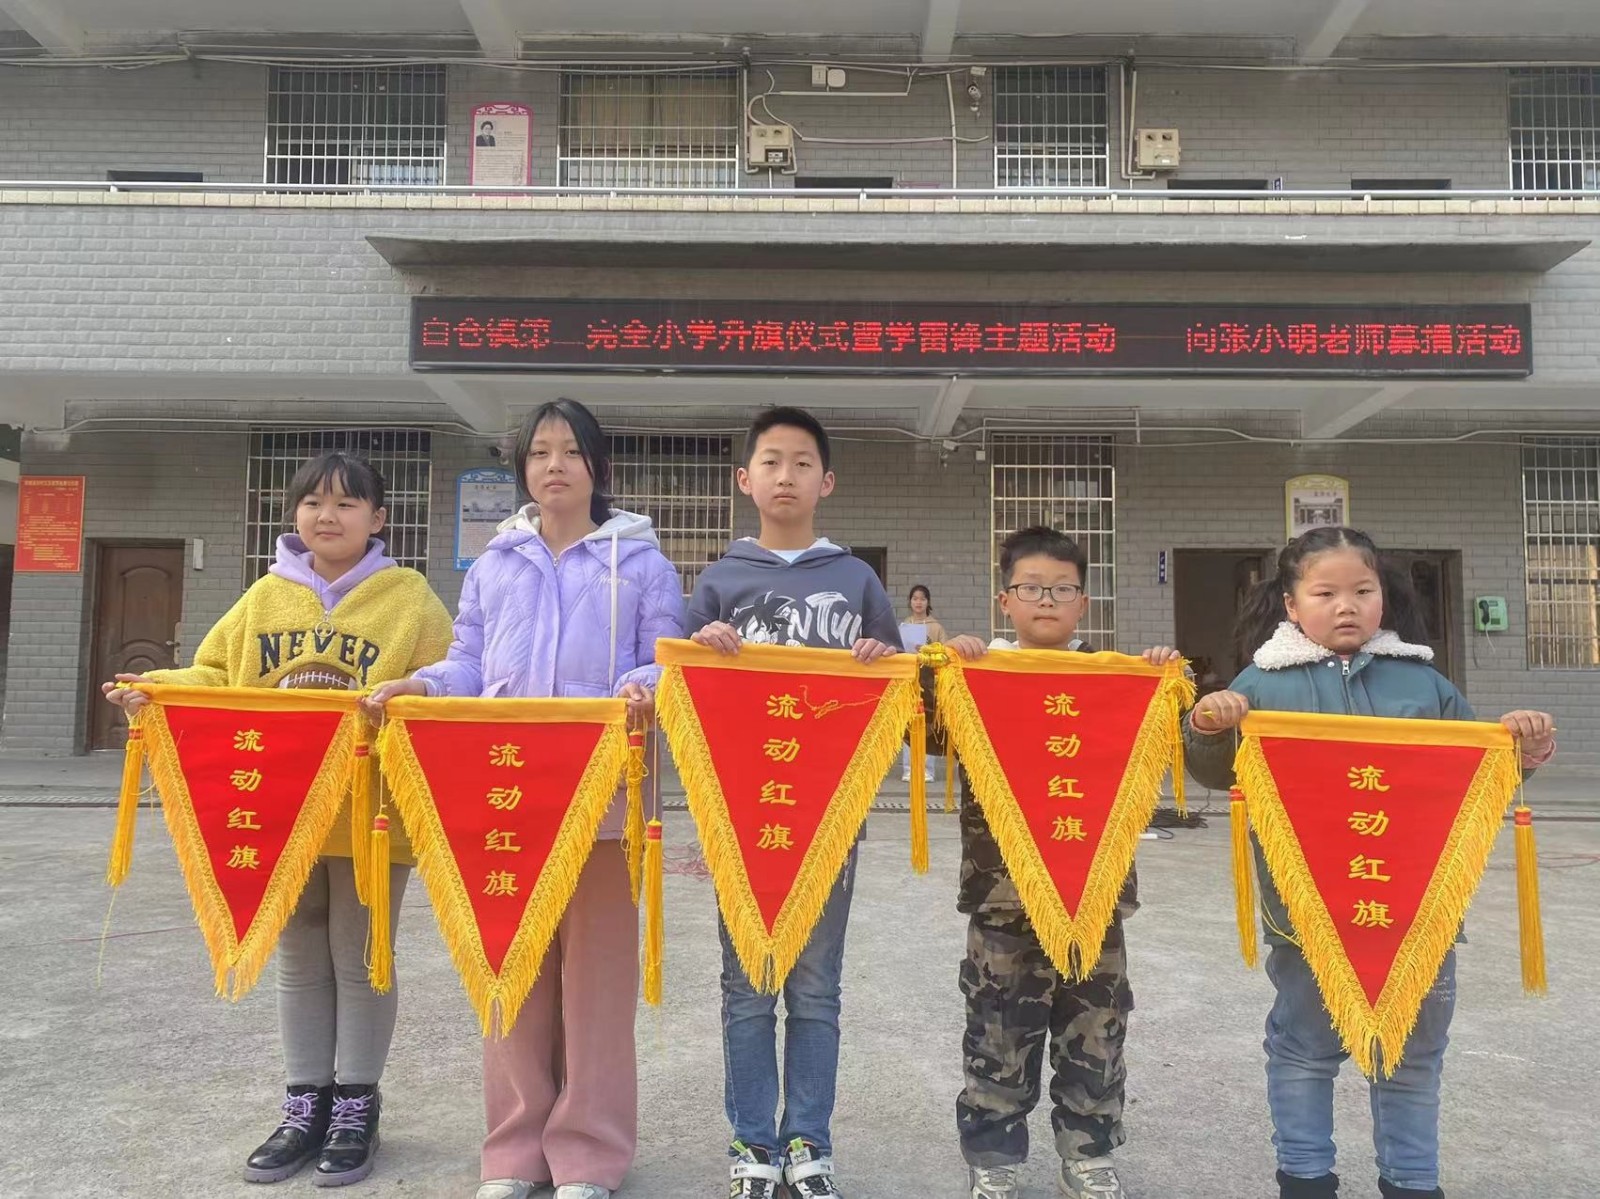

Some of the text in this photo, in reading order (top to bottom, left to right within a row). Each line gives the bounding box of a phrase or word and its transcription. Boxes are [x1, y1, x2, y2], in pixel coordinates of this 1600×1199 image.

[256, 629, 380, 688] NEVER
[227, 729, 264, 872] 流动红旗
[482, 743, 524, 898] 流动红旗
[757, 694, 801, 851] 流动红旗
[1043, 693, 1088, 842] 流动红旗
[1348, 765, 1394, 930] 流动红旗
